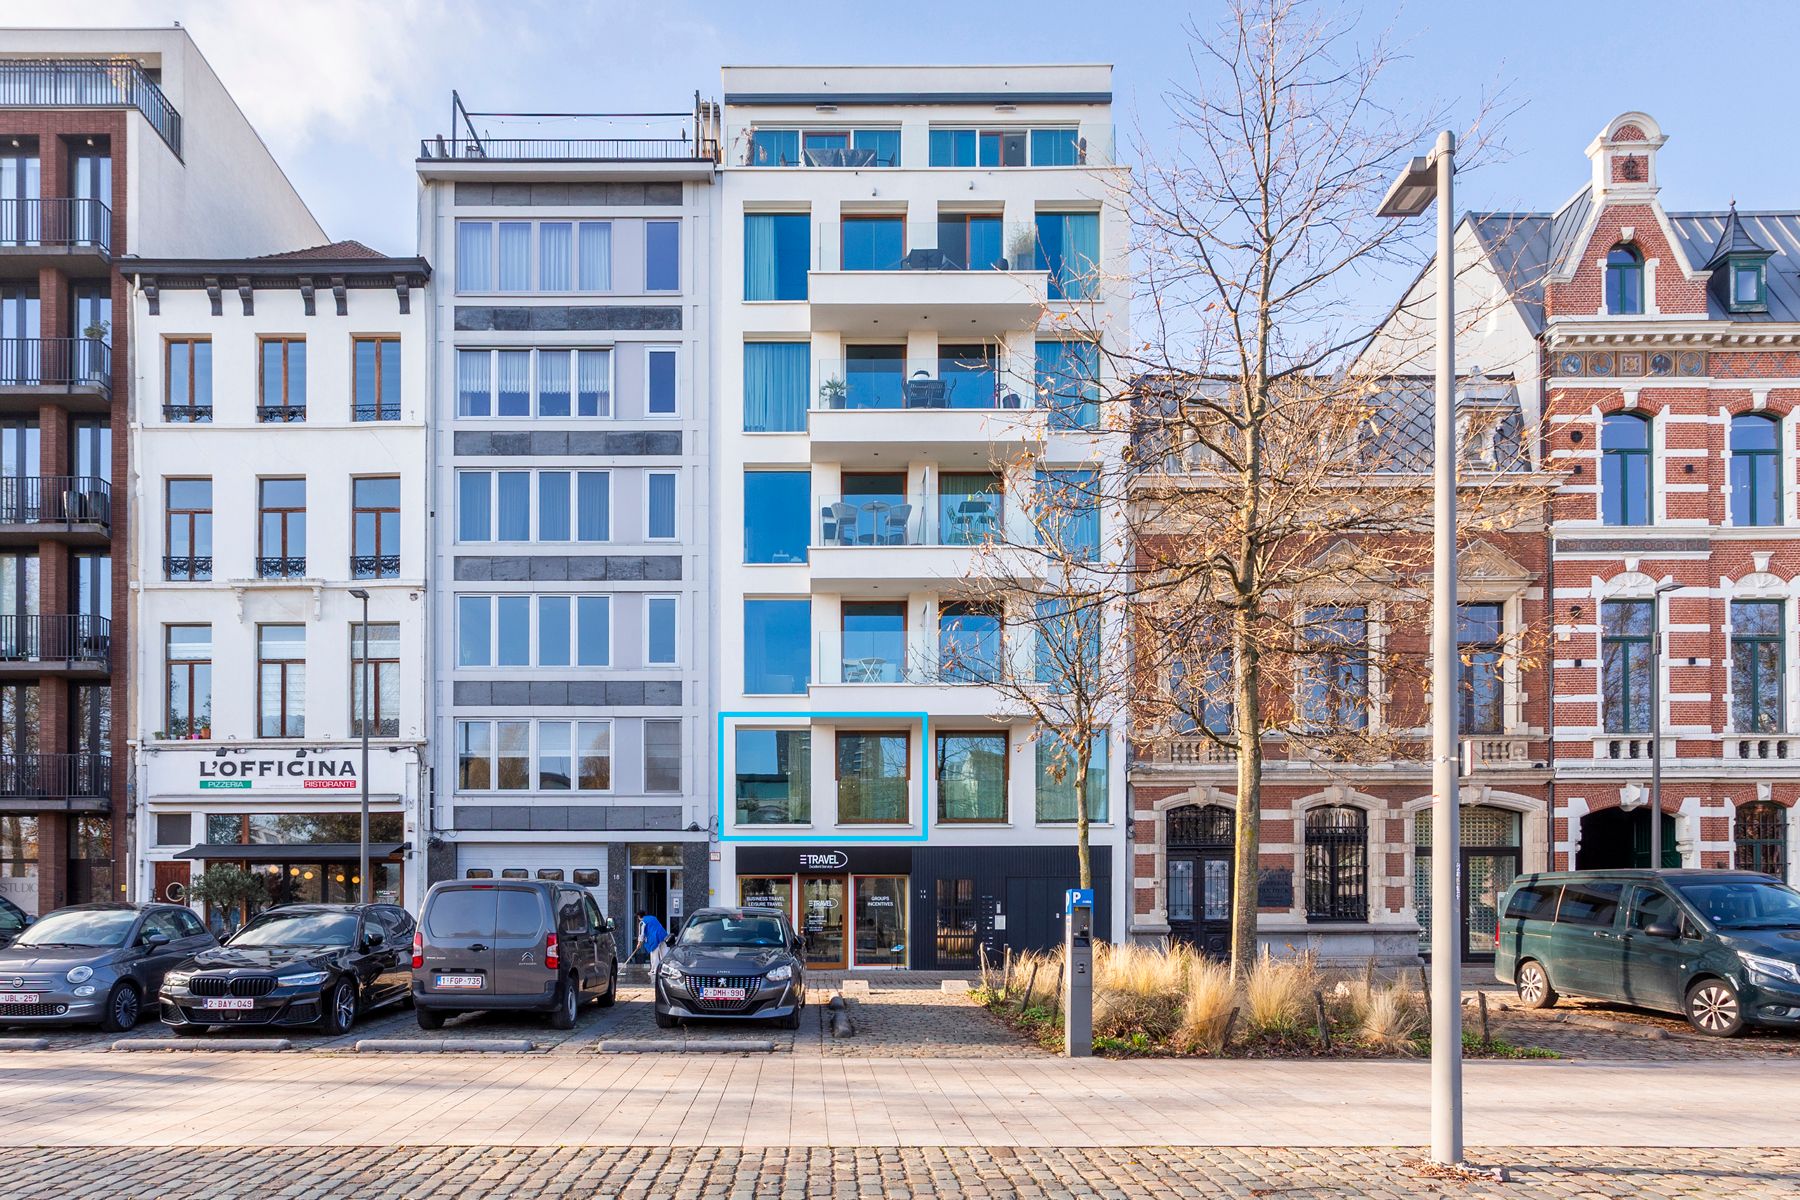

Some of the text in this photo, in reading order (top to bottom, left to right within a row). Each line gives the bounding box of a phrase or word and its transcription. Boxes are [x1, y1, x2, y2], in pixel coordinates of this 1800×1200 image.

[199, 760, 357, 777] L'OFFICINA
[208, 780, 244, 788] PIZZERIA
[304, 780, 355, 788] RISTORANTE
[1072, 891, 1082, 904] P
